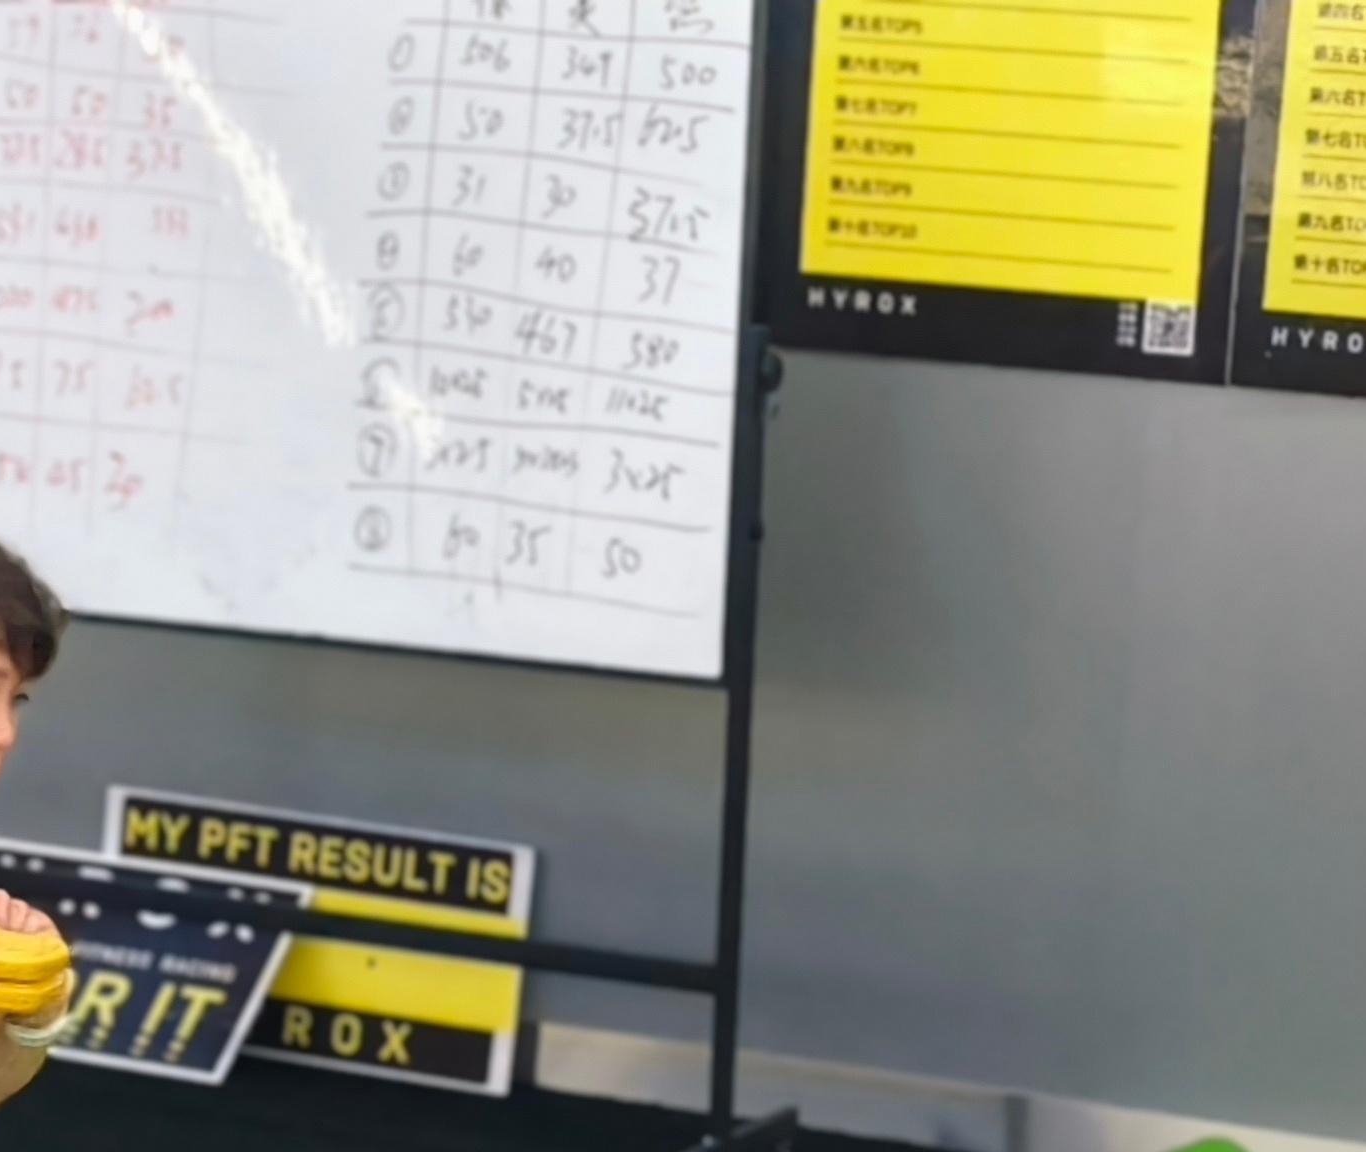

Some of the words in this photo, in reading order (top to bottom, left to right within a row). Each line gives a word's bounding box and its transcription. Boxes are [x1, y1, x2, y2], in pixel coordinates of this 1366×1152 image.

[660, 54, 717, 90] 500
[534, 246, 576, 283] 40
[636, 253, 681, 304] 37
[807, 286, 916, 316] HYROX
[505, 521, 552, 566] 35
[602, 536, 642, 579] 50
[124, 807, 189, 854] MY
[197, 817, 279, 870] PFT
[288, 829, 456, 894] RESULT
[466, 857, 511, 903] IS
[131, 980, 227, 1064] IT
[282, 1006, 412, 1065] ROX
